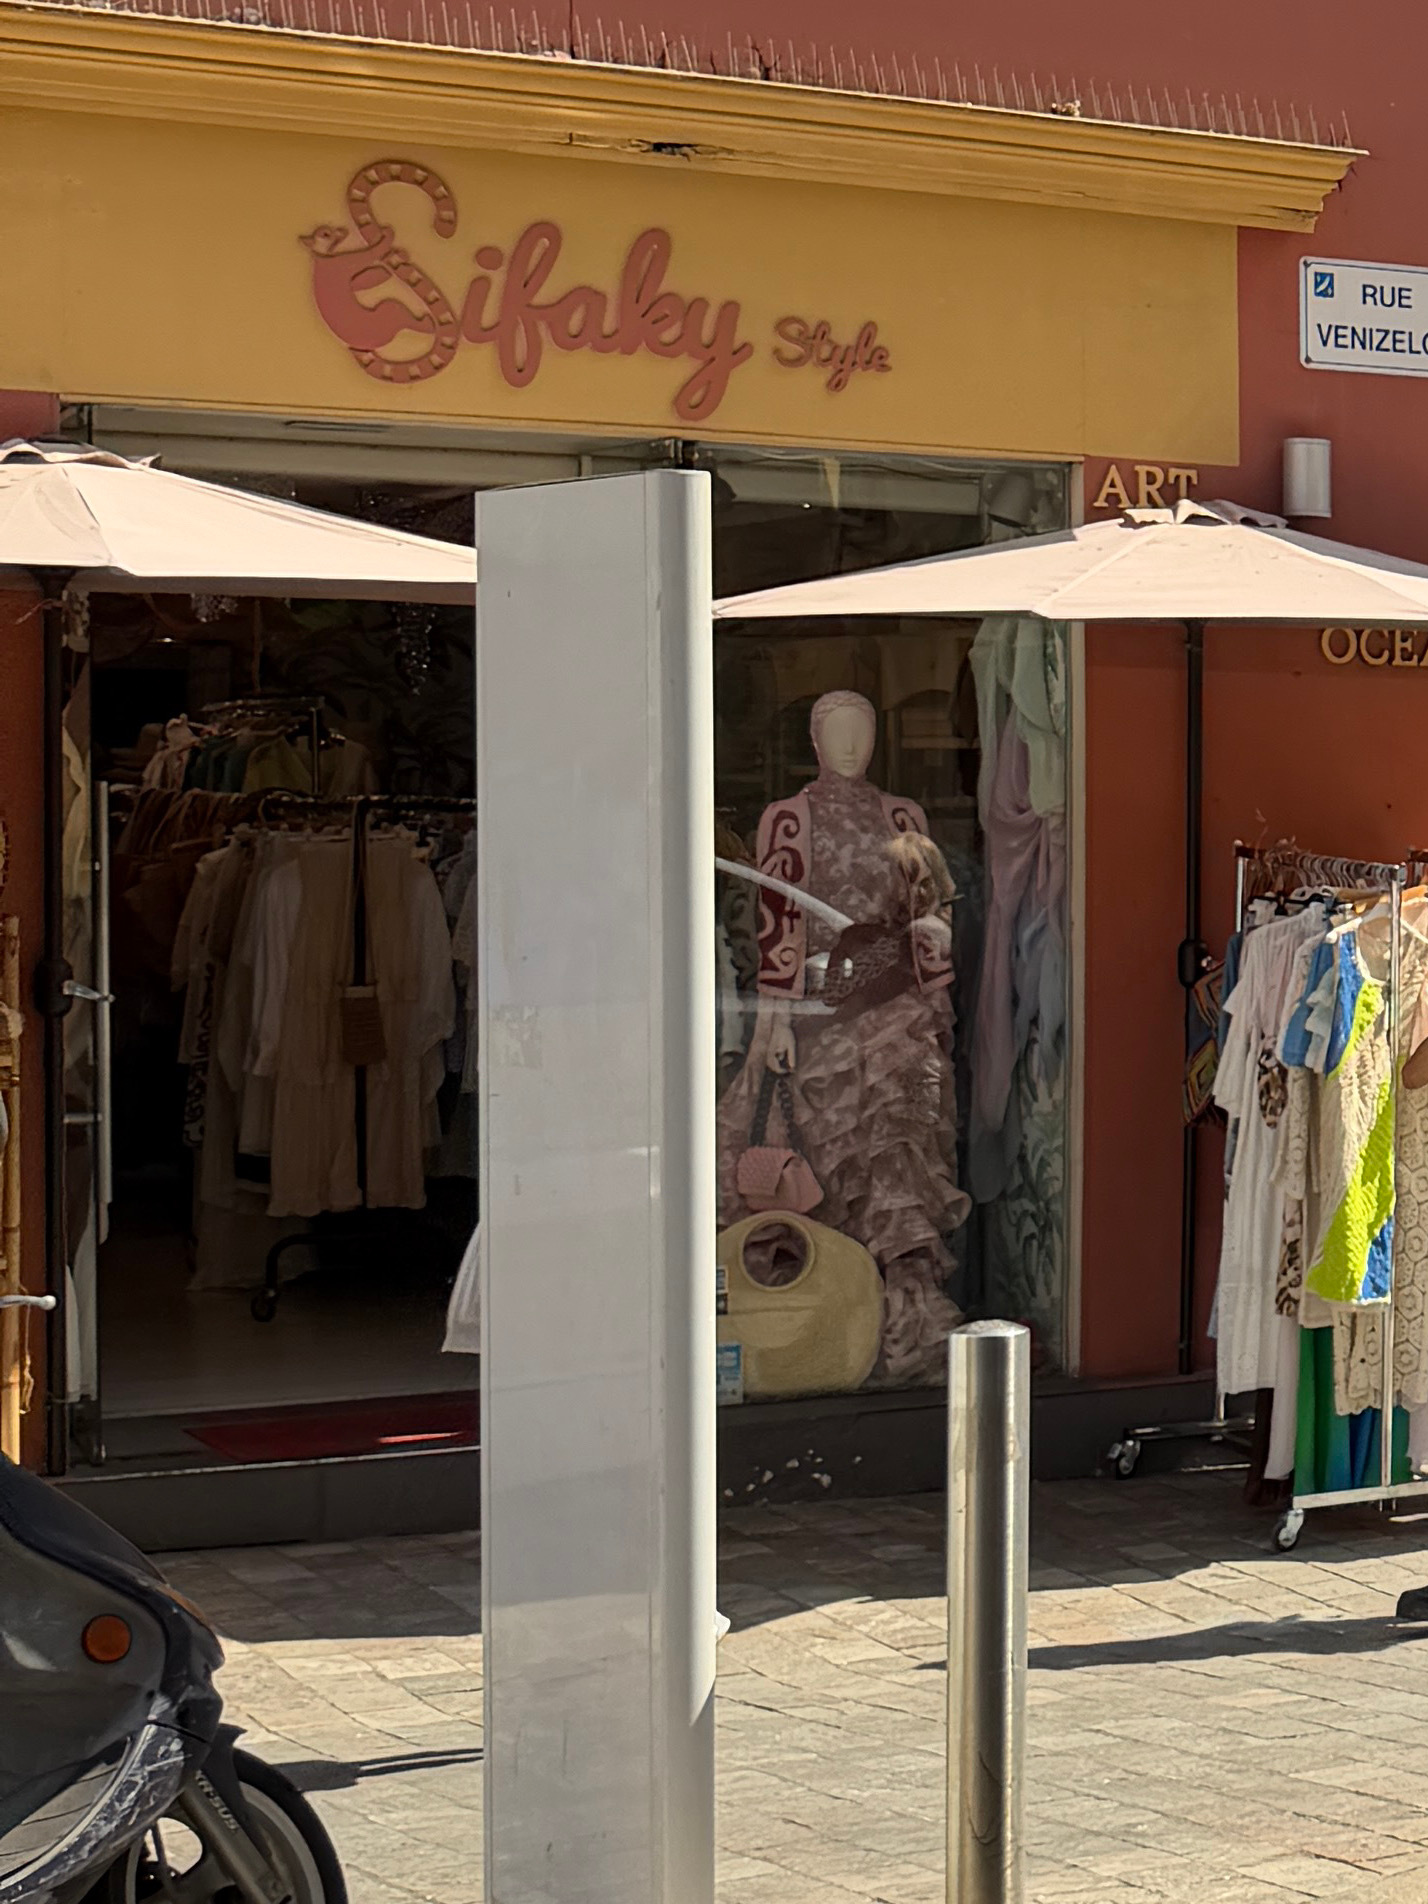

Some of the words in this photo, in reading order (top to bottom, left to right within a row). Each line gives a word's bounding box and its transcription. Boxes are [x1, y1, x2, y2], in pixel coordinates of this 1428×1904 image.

[313, 158, 753, 422] Sifaky
[773, 316, 892, 393] Style
[1362, 284, 1413, 309] RUE
[1093, 464, 1198, 508] ART
